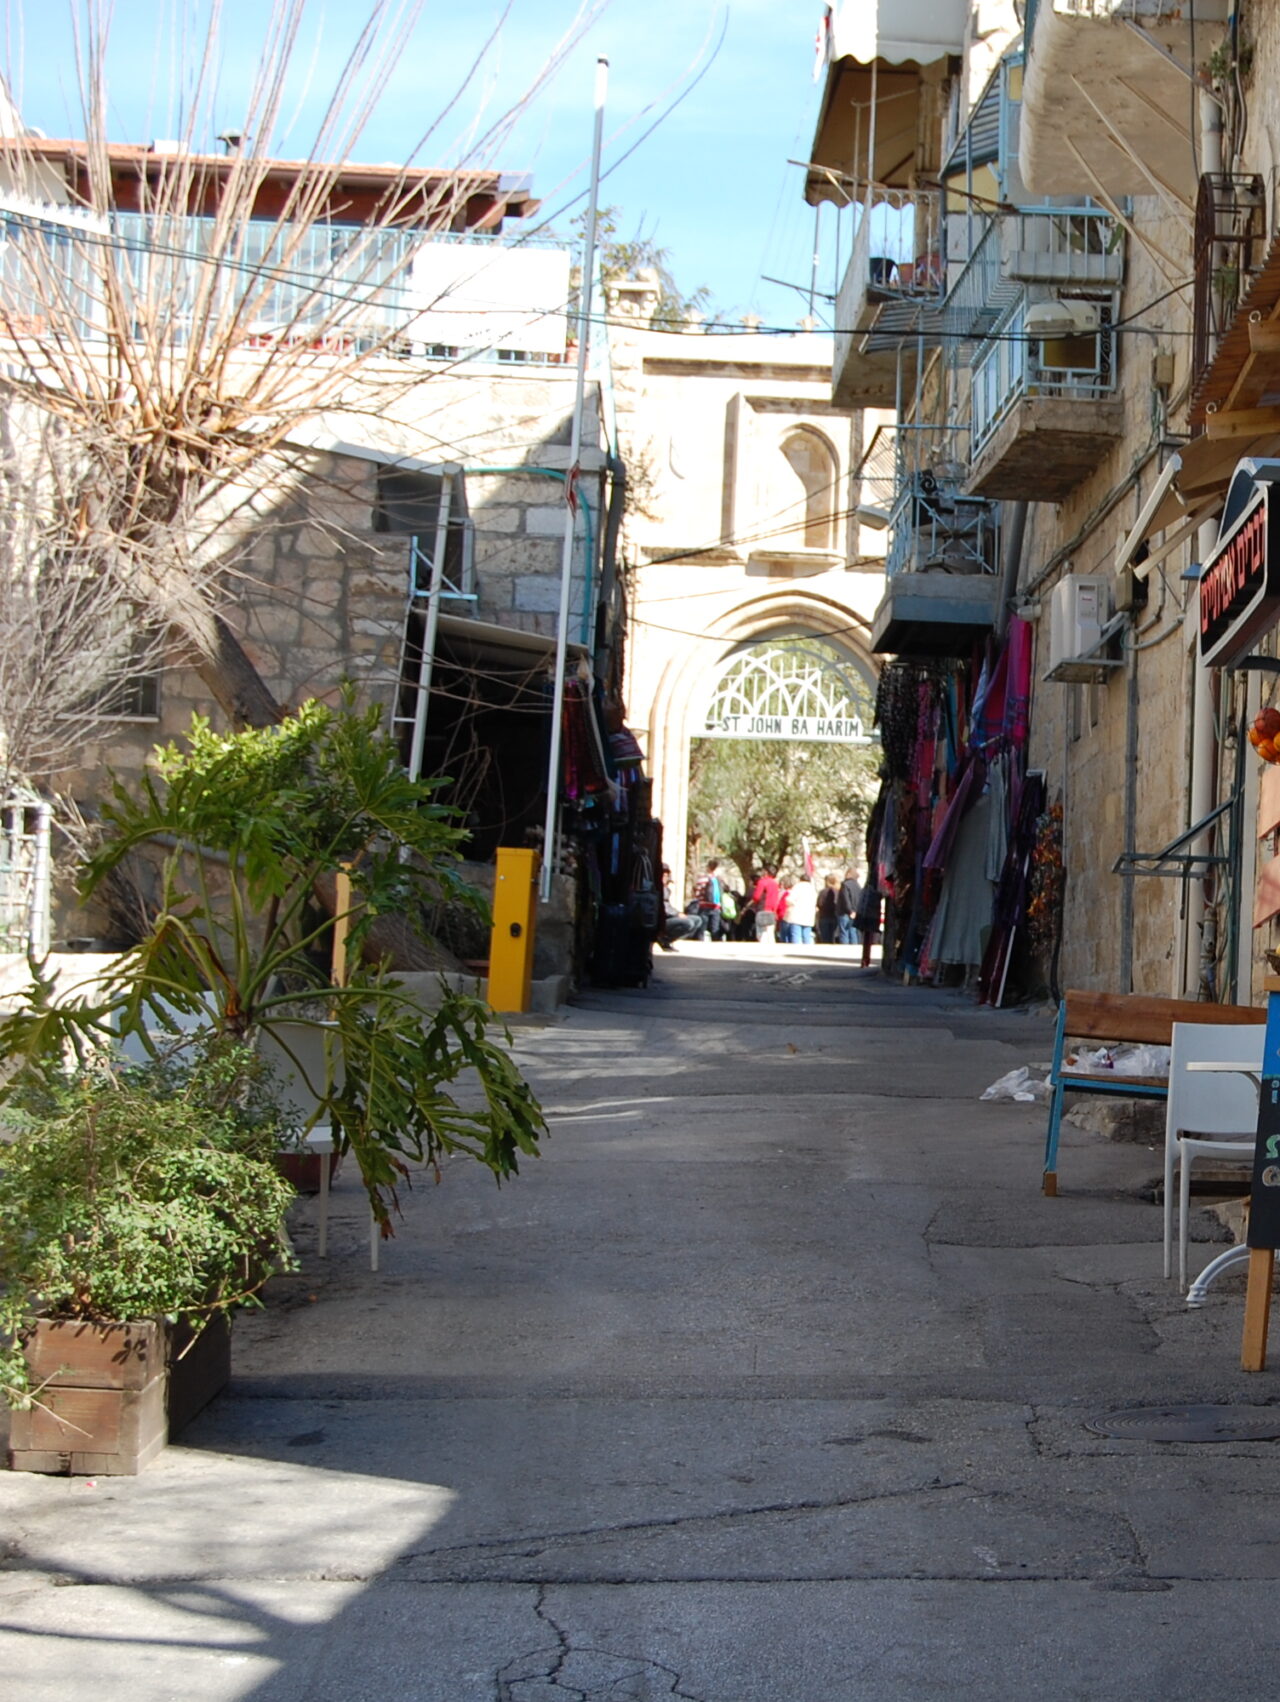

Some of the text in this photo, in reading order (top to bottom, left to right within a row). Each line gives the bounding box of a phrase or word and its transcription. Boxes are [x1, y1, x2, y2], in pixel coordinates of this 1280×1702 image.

[722, 716, 859, 737] ST JOHN BA HARIM
